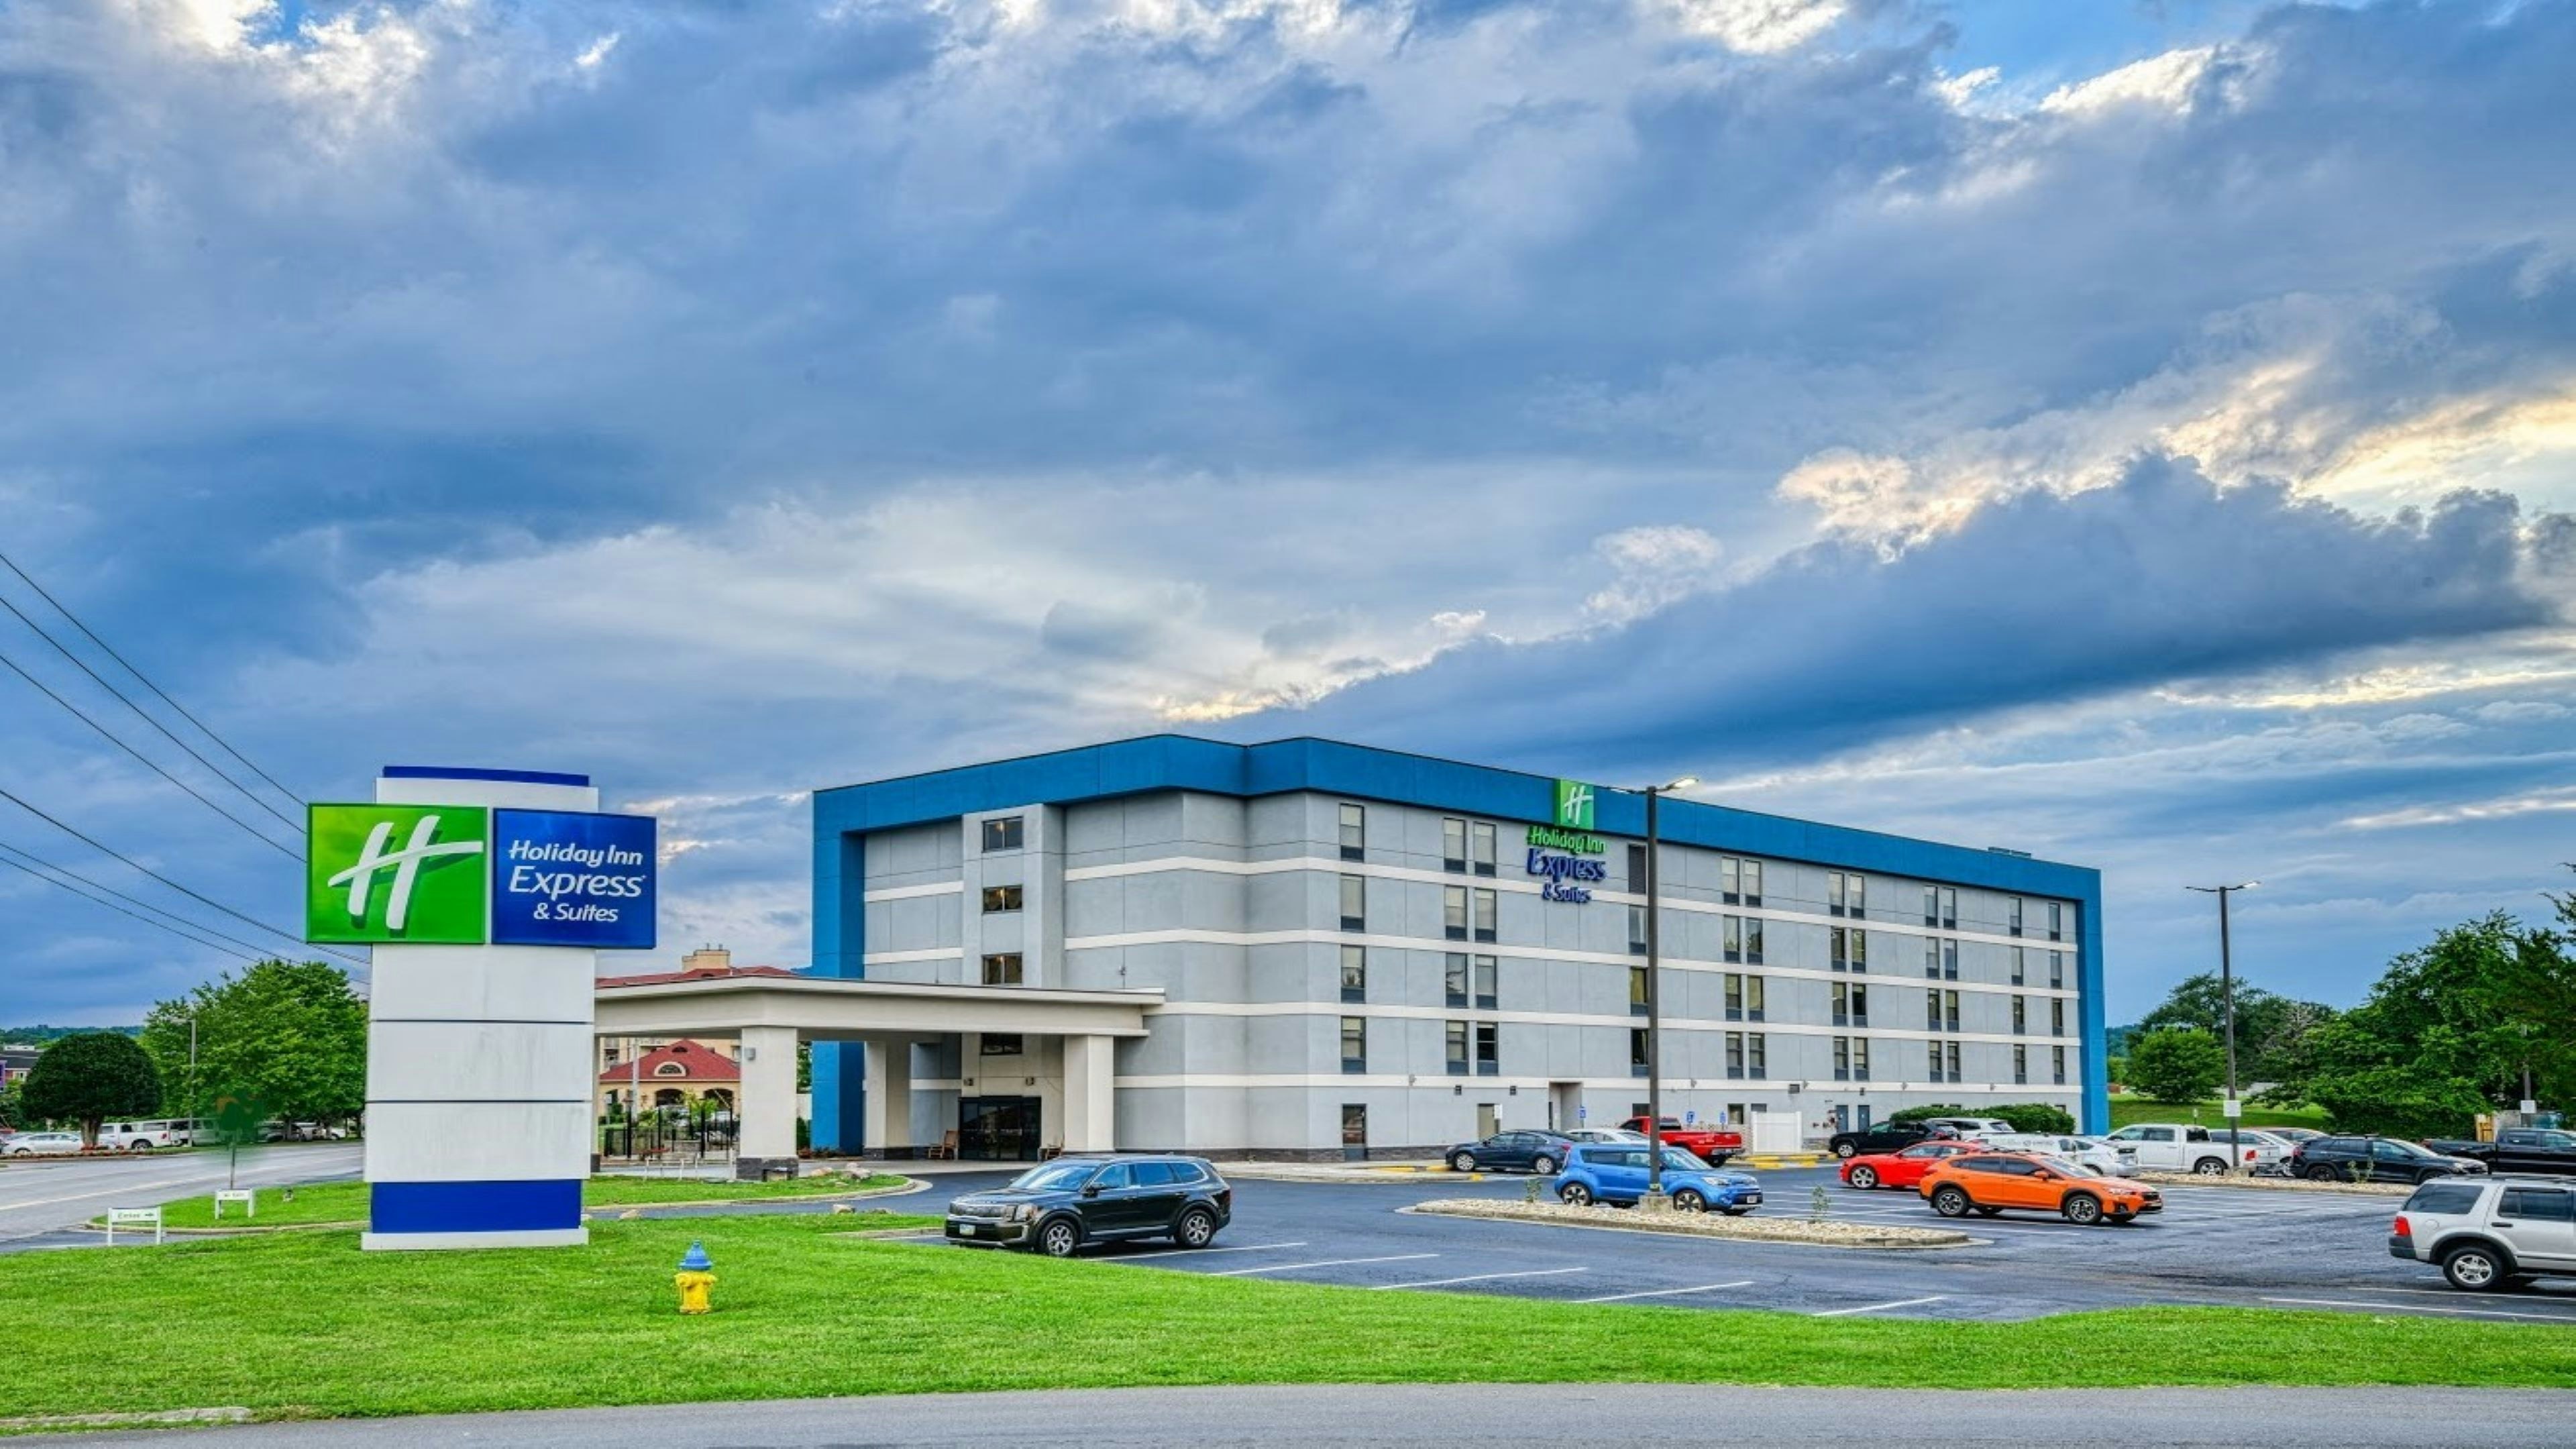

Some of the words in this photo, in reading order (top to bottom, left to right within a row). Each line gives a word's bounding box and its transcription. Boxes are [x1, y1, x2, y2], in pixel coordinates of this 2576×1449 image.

[508, 840, 604, 868] Holiday
[607, 844, 643, 865] Inn
[1526, 826, 1586, 854] Holiday
[1587, 835, 1606, 853] Inn
[1526, 847, 1606, 882] Express
[508, 865, 642, 901] Express
[1542, 883, 1552, 900] &
[1552, 884, 1592, 902] Suites
[533, 902, 550, 920] &
[553, 902, 619, 922] Suites
